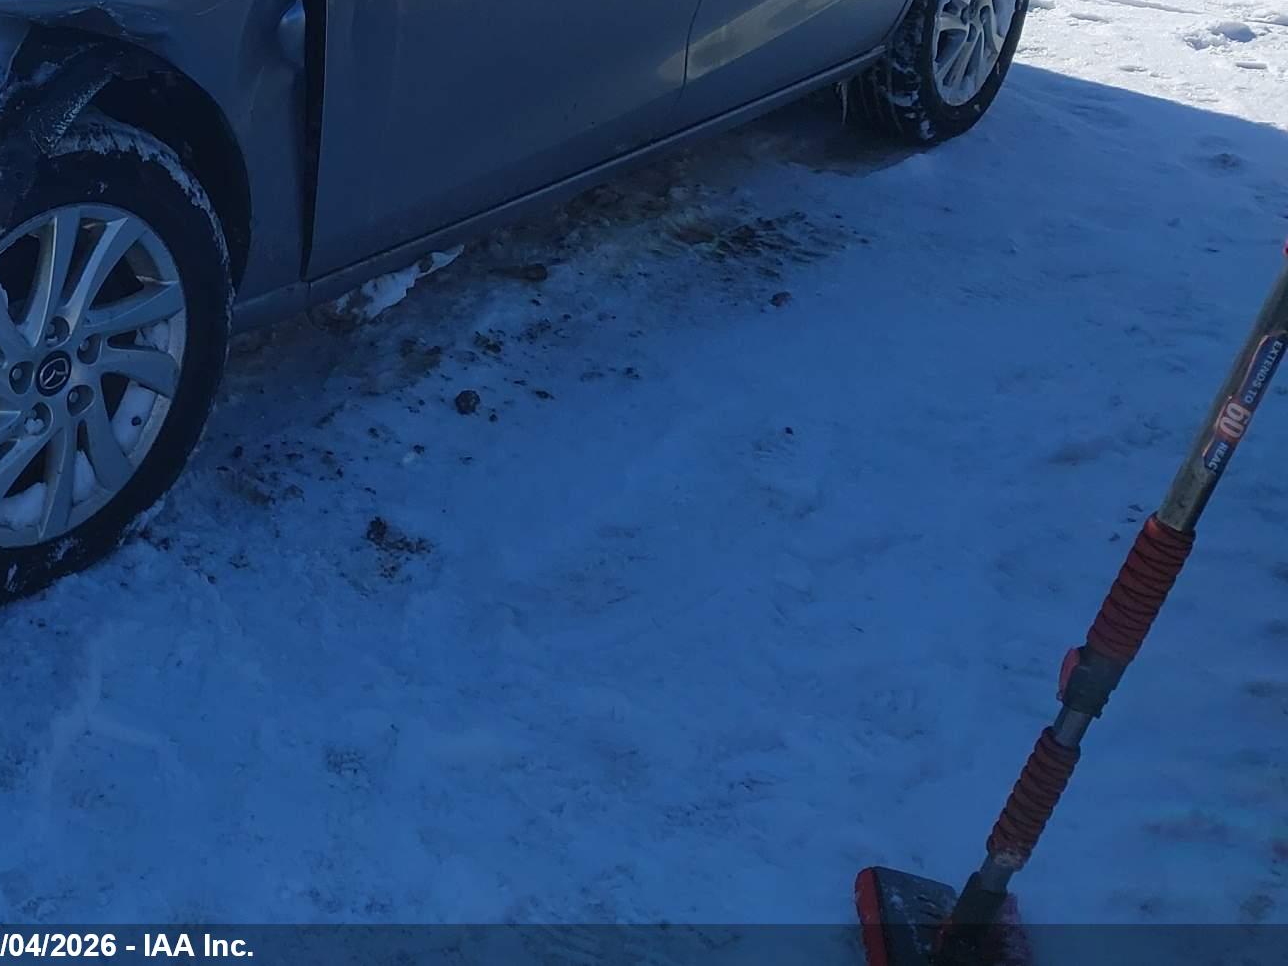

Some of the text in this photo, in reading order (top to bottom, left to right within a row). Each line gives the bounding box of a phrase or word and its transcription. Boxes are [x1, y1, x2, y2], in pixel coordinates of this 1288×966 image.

[1252, 340, 1284, 389] EXTENDS
[1244, 389, 1258, 405] TO
[1208, 441, 1229, 471] REAC
